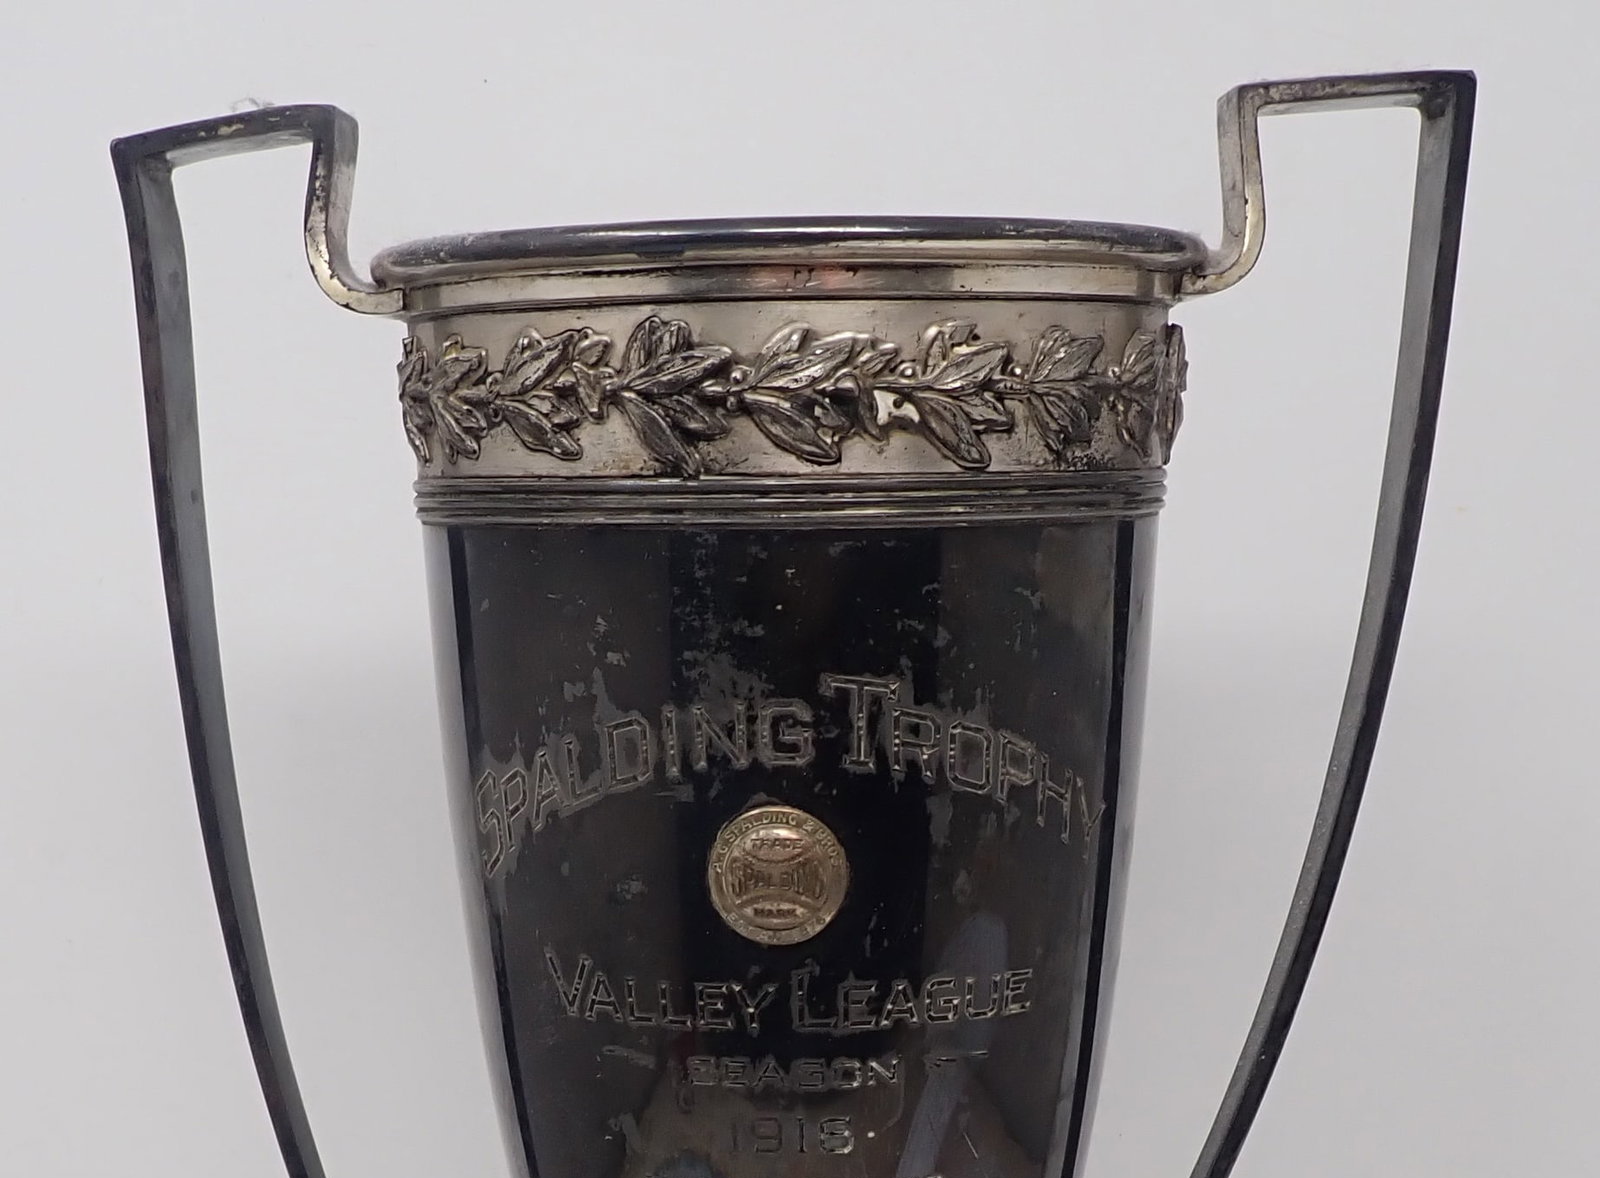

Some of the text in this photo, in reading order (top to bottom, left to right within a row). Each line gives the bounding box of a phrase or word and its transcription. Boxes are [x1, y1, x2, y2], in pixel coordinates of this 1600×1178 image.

[475, 672, 1106, 877] SPALDING TROPHY
[750, 838, 805, 851] TRADE
[544, 943, 1033, 1036] VALLEY LEAGUE
[687, 1055, 900, 1091] SEASON
